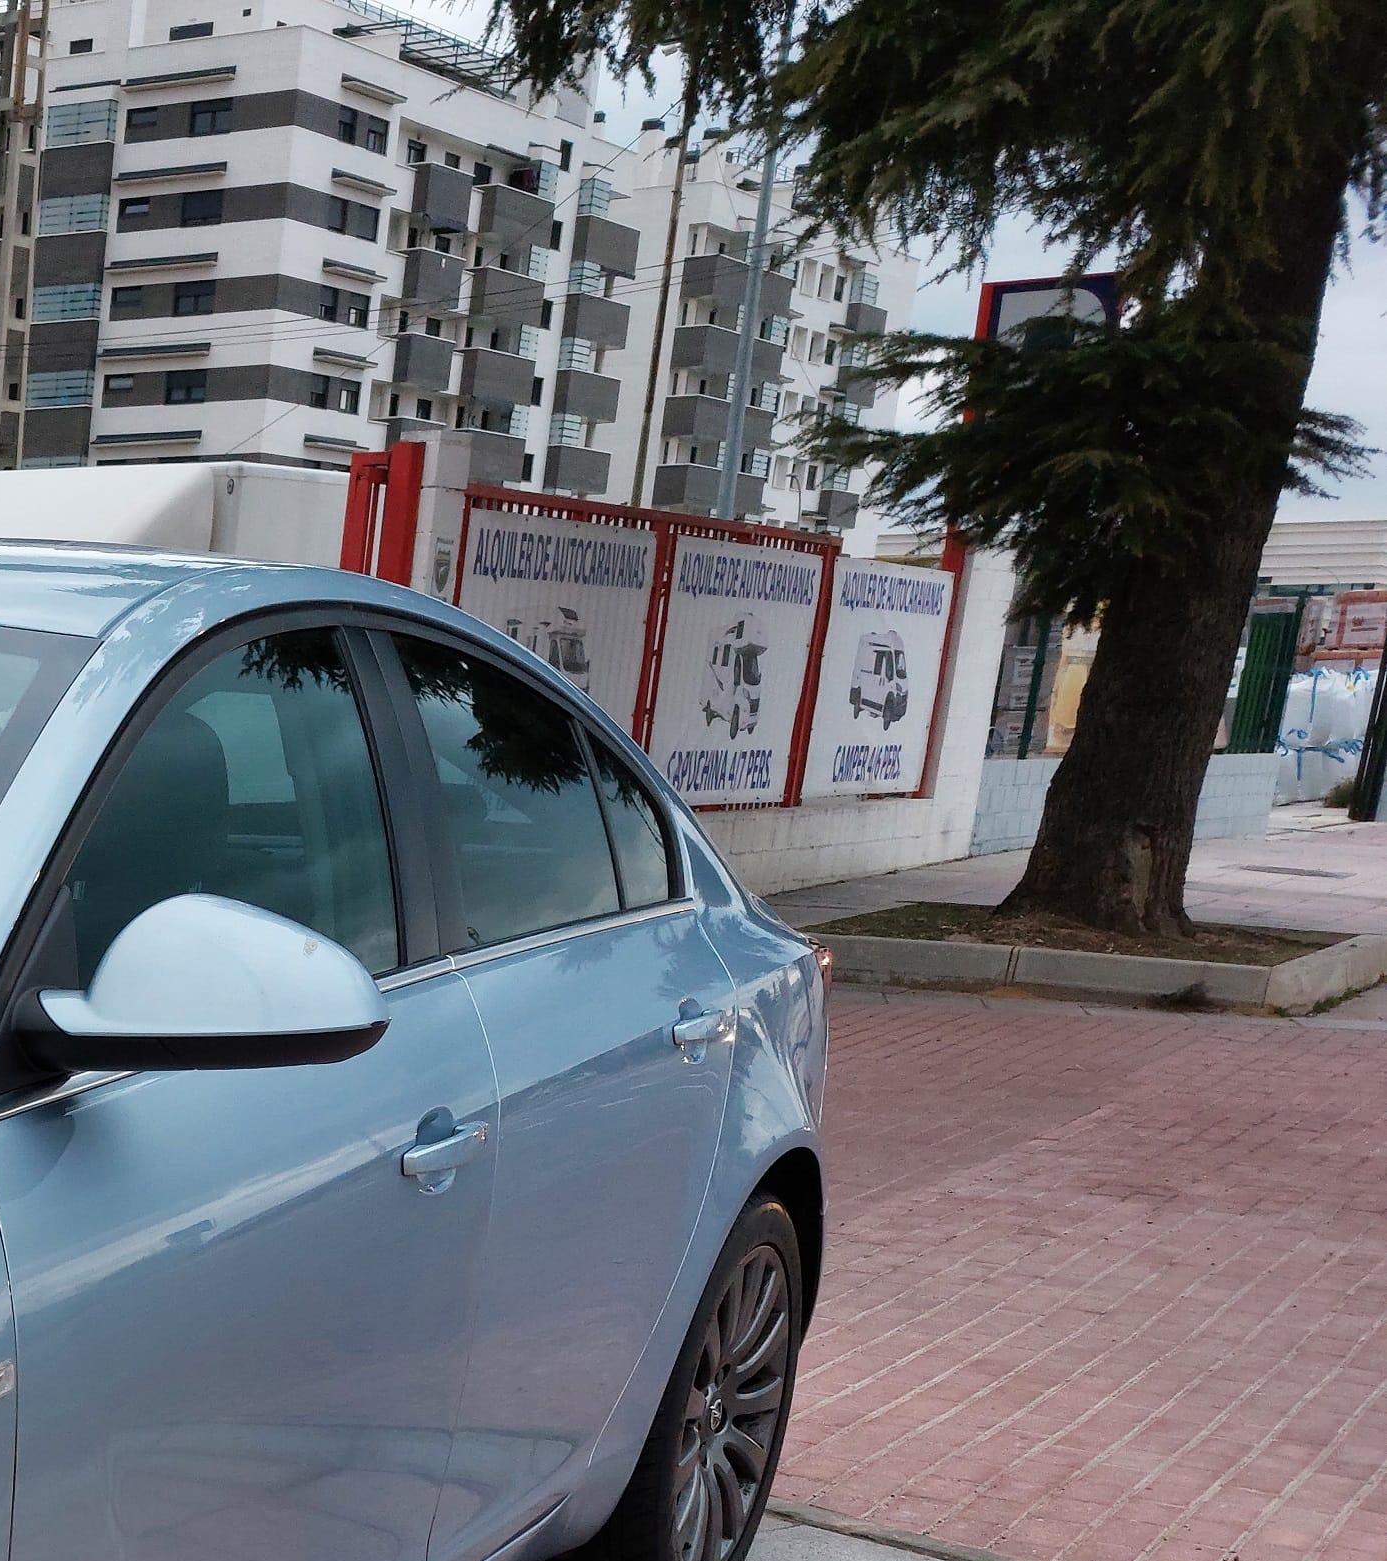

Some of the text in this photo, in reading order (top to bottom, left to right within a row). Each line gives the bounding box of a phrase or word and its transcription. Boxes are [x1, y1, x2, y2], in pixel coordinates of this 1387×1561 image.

[473, 528, 648, 590] ALQUILER DE AUTOCARAVANAS
[678, 551, 817, 606] ALQUILER DE AUTOCARAVANAS
[840, 571, 945, 616] ALQUILER DE AUTOCARAVANAS
[667, 750, 728, 793] CAPUCHINA
[746, 749, 773, 790] PERS.
[832, 744, 870, 783] CAMPER
[880, 744, 903, 779] PERS.
